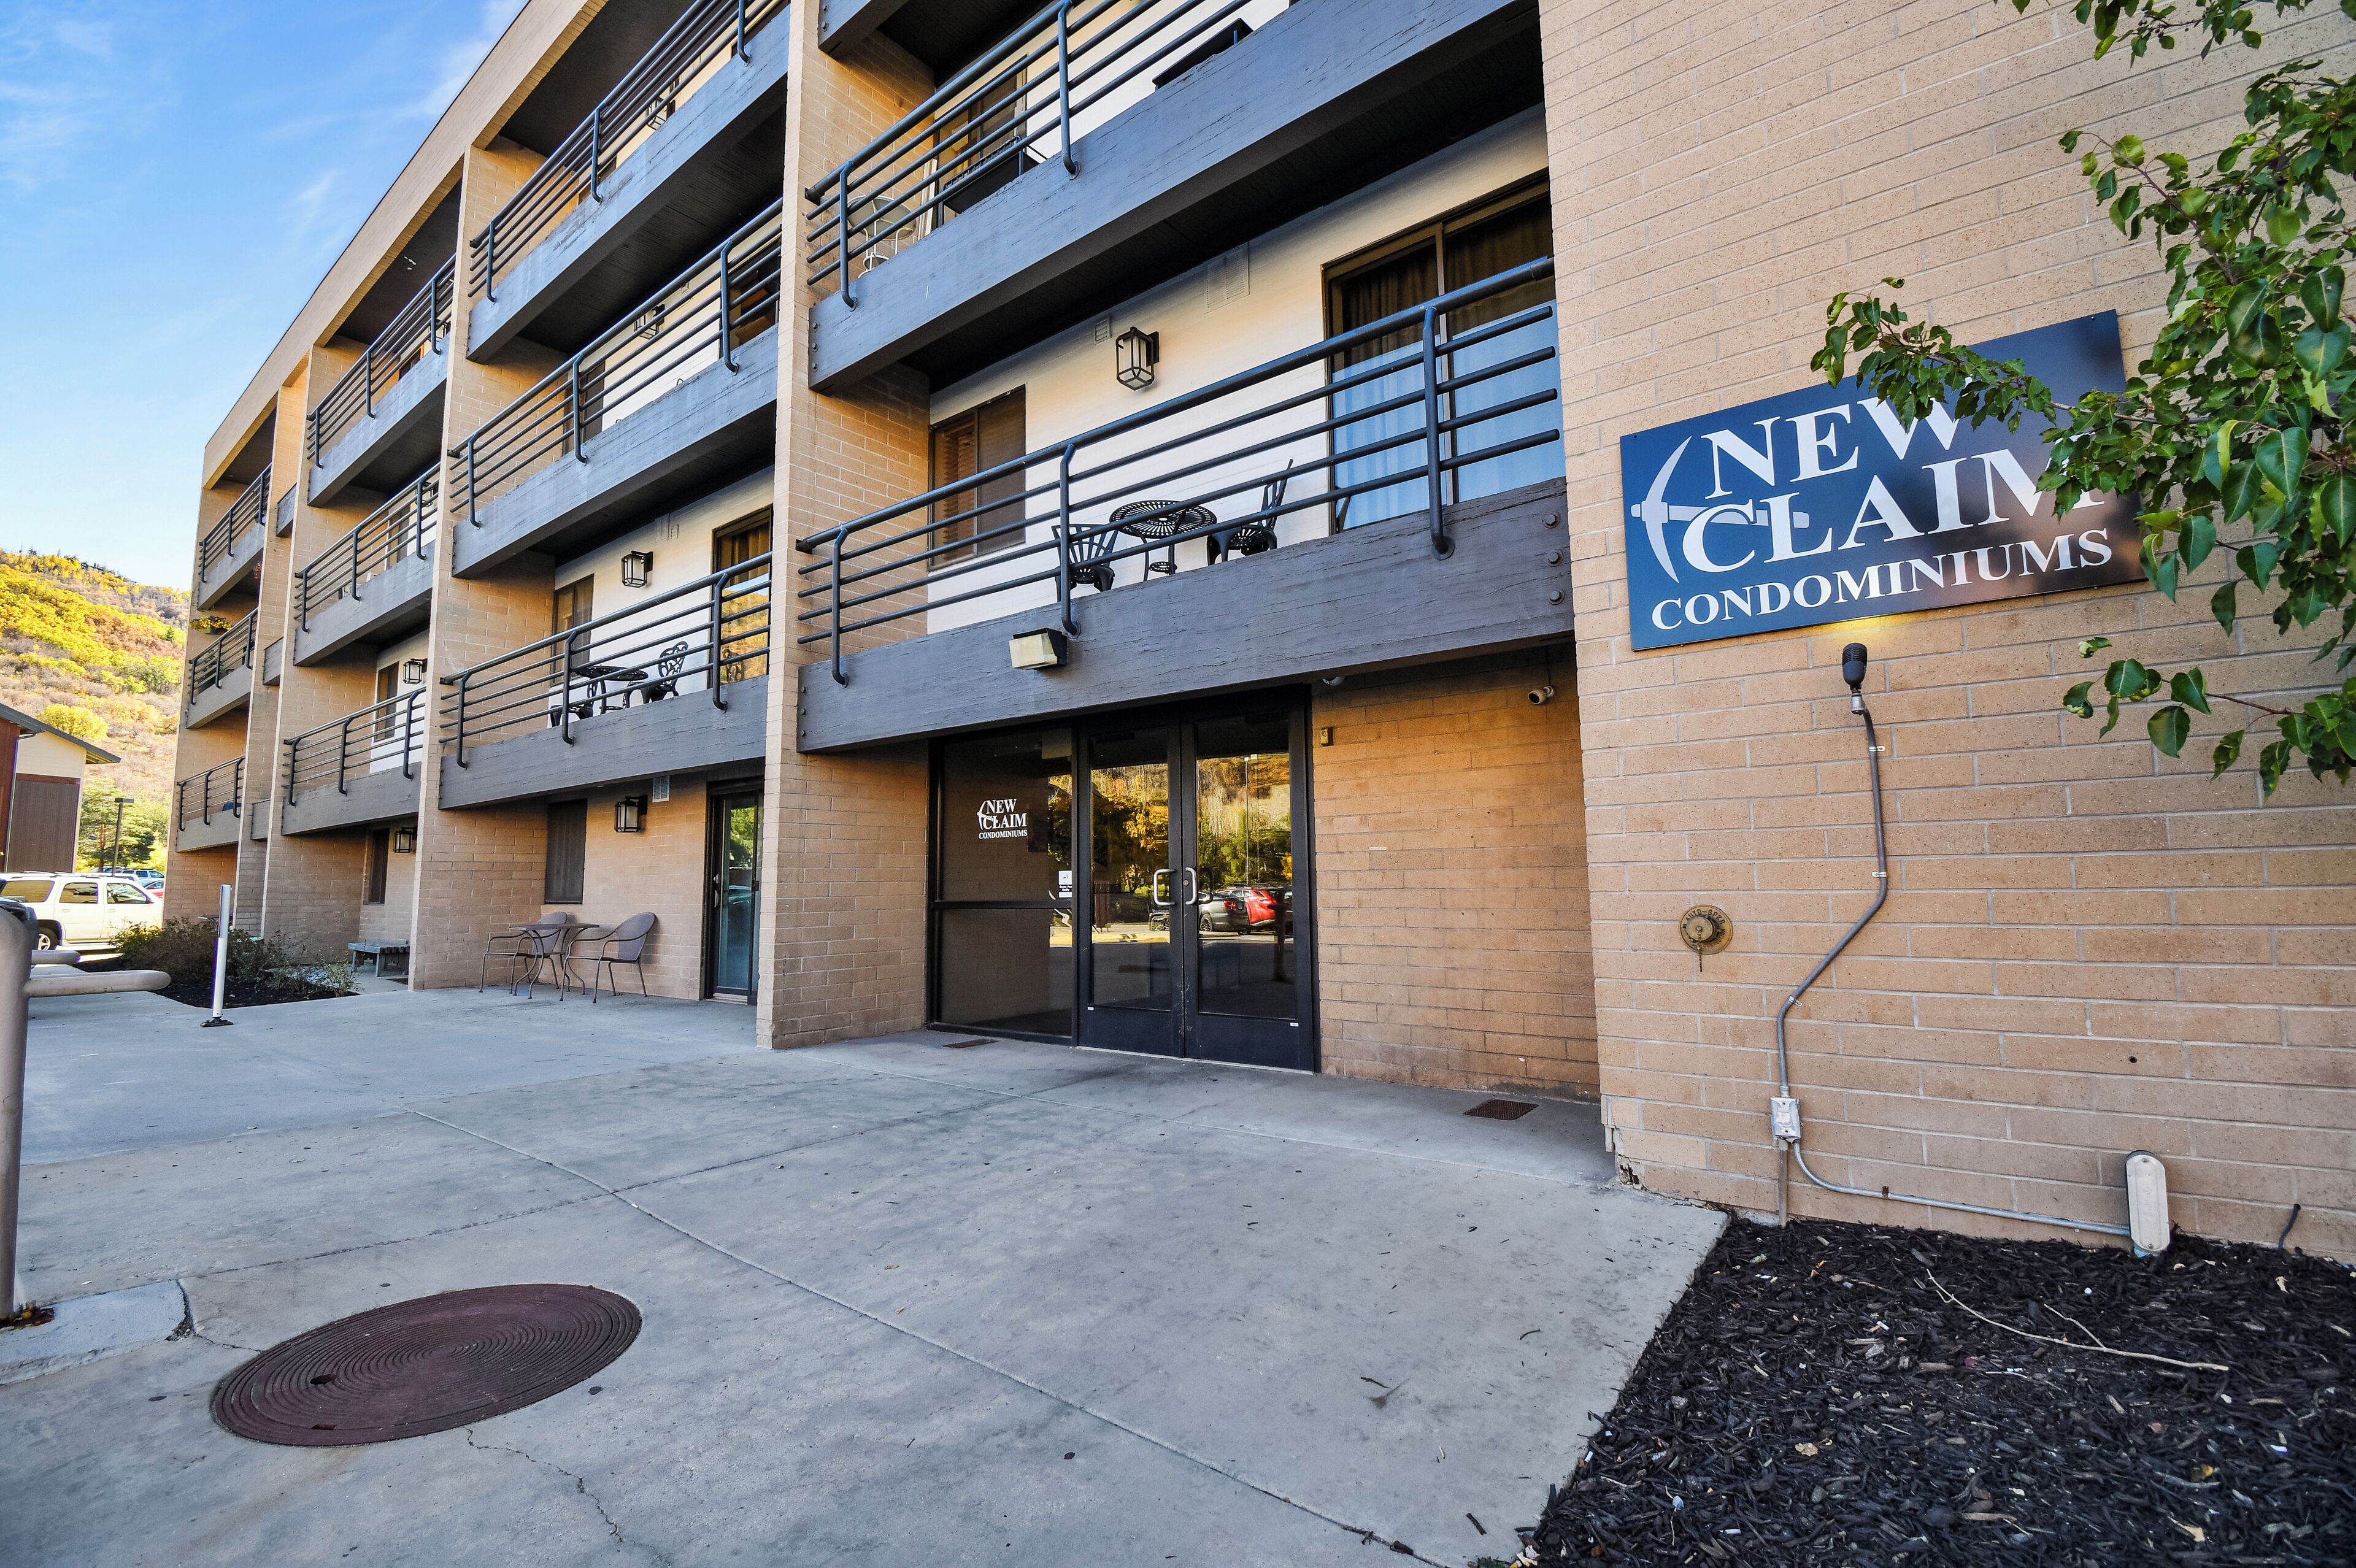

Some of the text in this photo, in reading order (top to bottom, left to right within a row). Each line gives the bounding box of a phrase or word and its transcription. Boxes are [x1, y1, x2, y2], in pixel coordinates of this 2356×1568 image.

[1701, 373, 1973, 499] NEW
[1682, 431, 2105, 573] CLAIM
[1652, 528, 2112, 631] CONDOMINIUMS
[979, 829, 1028, 840] CONDOMINIUMS
[983, 812, 1028, 830] CLAIM
[985, 798, 1017, 814] NEW
